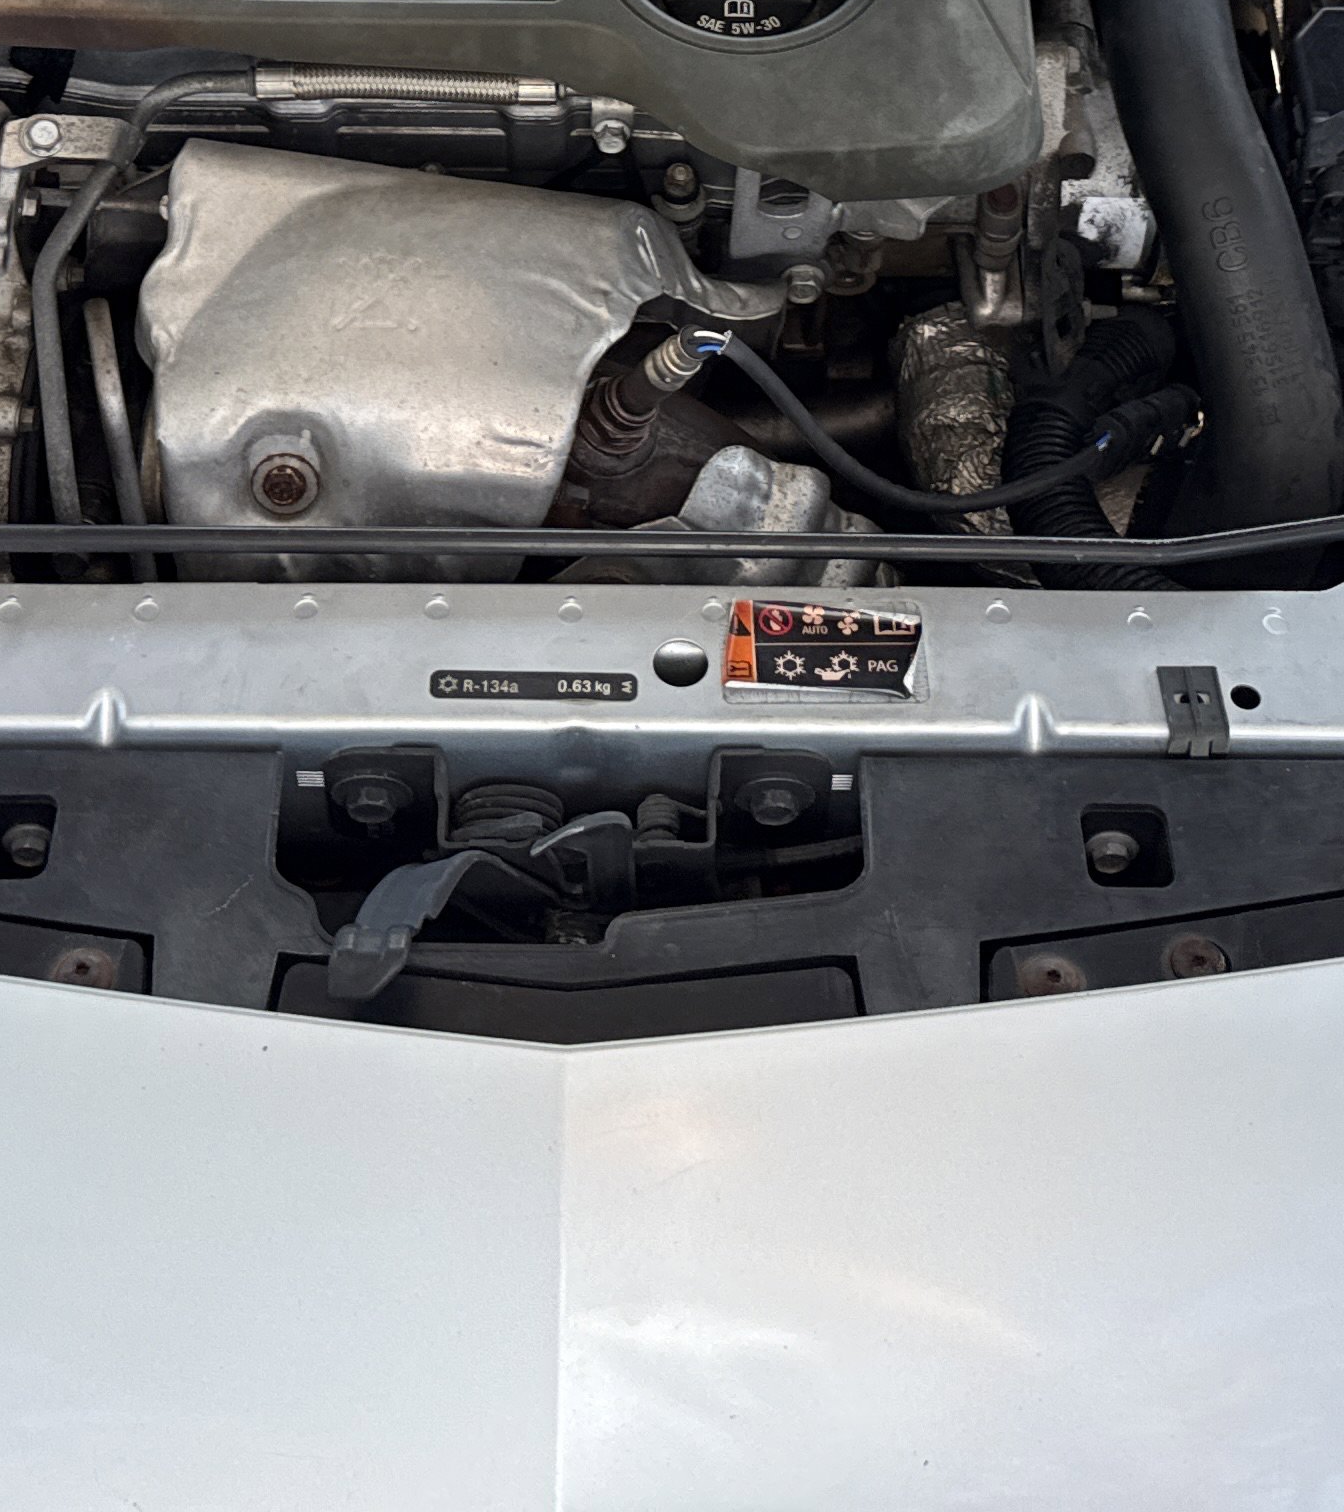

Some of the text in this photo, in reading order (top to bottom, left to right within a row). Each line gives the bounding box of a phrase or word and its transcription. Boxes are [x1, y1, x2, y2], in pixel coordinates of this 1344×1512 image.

[696, 14, 782, 35] SAE 5W-30
[1202, 195, 1249, 273] CB6
[802, 625, 828, 635] AUTO
[867, 660, 899, 673] PAG
[462, 678, 519, 694] R-134a
[557, 679, 592, 694] 0.63
[595, 680, 612, 696] kg
